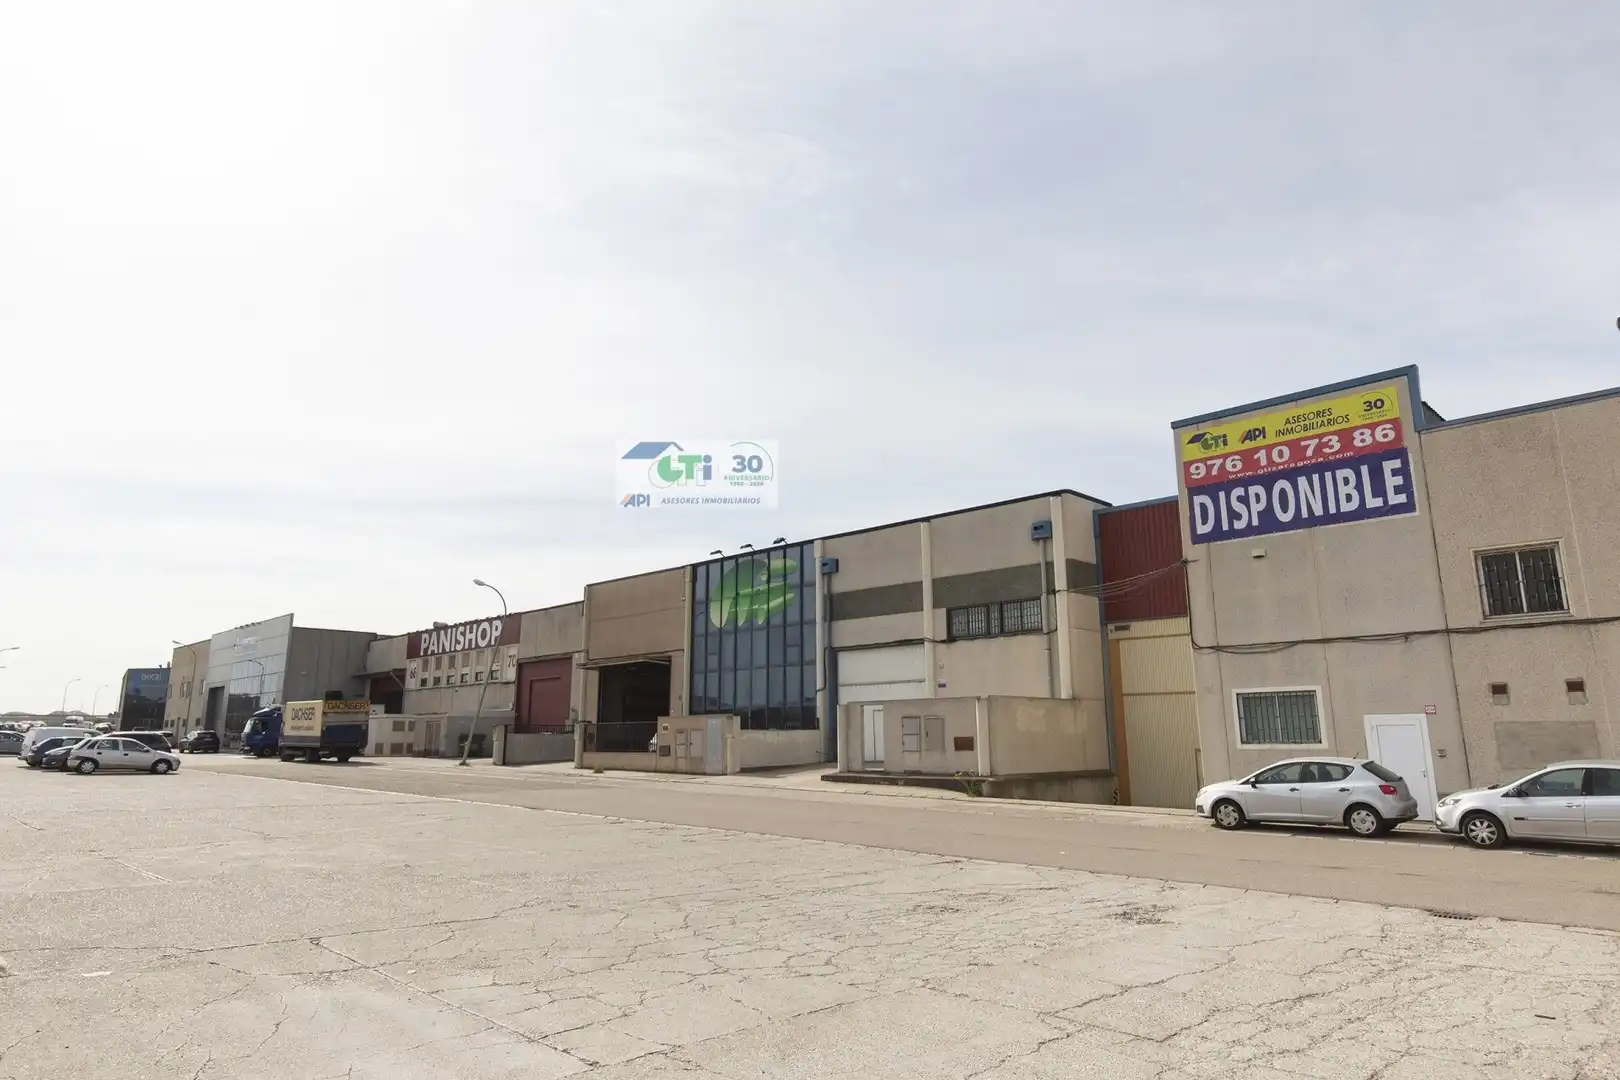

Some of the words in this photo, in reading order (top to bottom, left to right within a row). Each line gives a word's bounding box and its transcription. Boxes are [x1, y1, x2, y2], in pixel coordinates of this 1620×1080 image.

[1363, 398, 1385, 412] 30
[1275, 413, 1350, 438] INMOBILIARIOS
[1284, 407, 1333, 426] ASESORES
[1240, 426, 1266, 444] API
[1189, 455, 1243, 479] 976
[1253, 445, 1290, 466] 10
[1300, 434, 1341, 457] 73
[1352, 423, 1396, 447] 86
[1193, 458, 1408, 535] DISPONIBLE
[420, 619, 502, 656] PANISHOP
[291, 706, 316, 721] DACHSER
[327, 701, 367, 710] DACHSER
